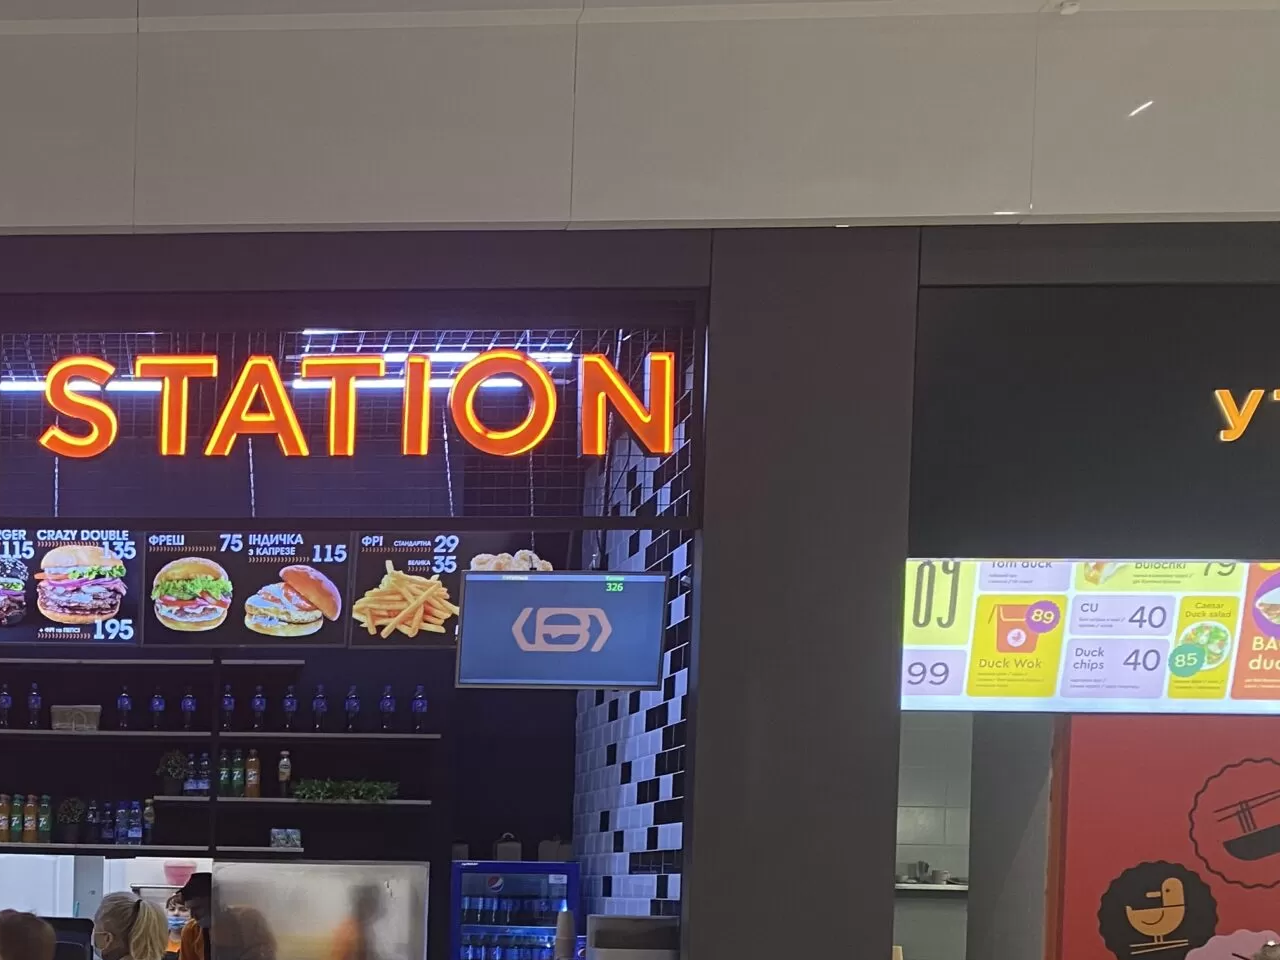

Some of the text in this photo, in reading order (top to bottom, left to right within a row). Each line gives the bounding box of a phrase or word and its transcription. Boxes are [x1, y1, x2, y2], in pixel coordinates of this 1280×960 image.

[38, 349, 673, 458] STATION
[1214, 388, 1280, 441] У
[37, 530, 129, 541] CRAZY DOUBLE
[148, 534, 185, 546] ФРЕШ
[219, 534, 243, 552] 75
[248, 533, 304, 546] ІНДИЧКА
[361, 535, 384, 546] ФРІ
[433, 534, 459, 553] 29
[1, 541, 35, 559] 115
[101, 541, 137, 560] 135
[256, 547, 296, 556] КАПРЕЗЕ
[312, 544, 347, 563] 115
[432, 555, 457, 574] 35
[605, 582, 624, 592] 326
[1031, 608, 1055, 625] 89
[1128, 606, 1168, 629] 40
[93, 619, 134, 640] 195
[1252, 636, 1280, 651] BA
[1075, 647, 1105, 658] Duck
[1123, 649, 1161, 672] 40
[1174, 652, 1198, 668] 85
[978, 657, 1042, 669] Duck Wok
[1073, 659, 1105, 672] chips
[907, 661, 950, 685] 99
